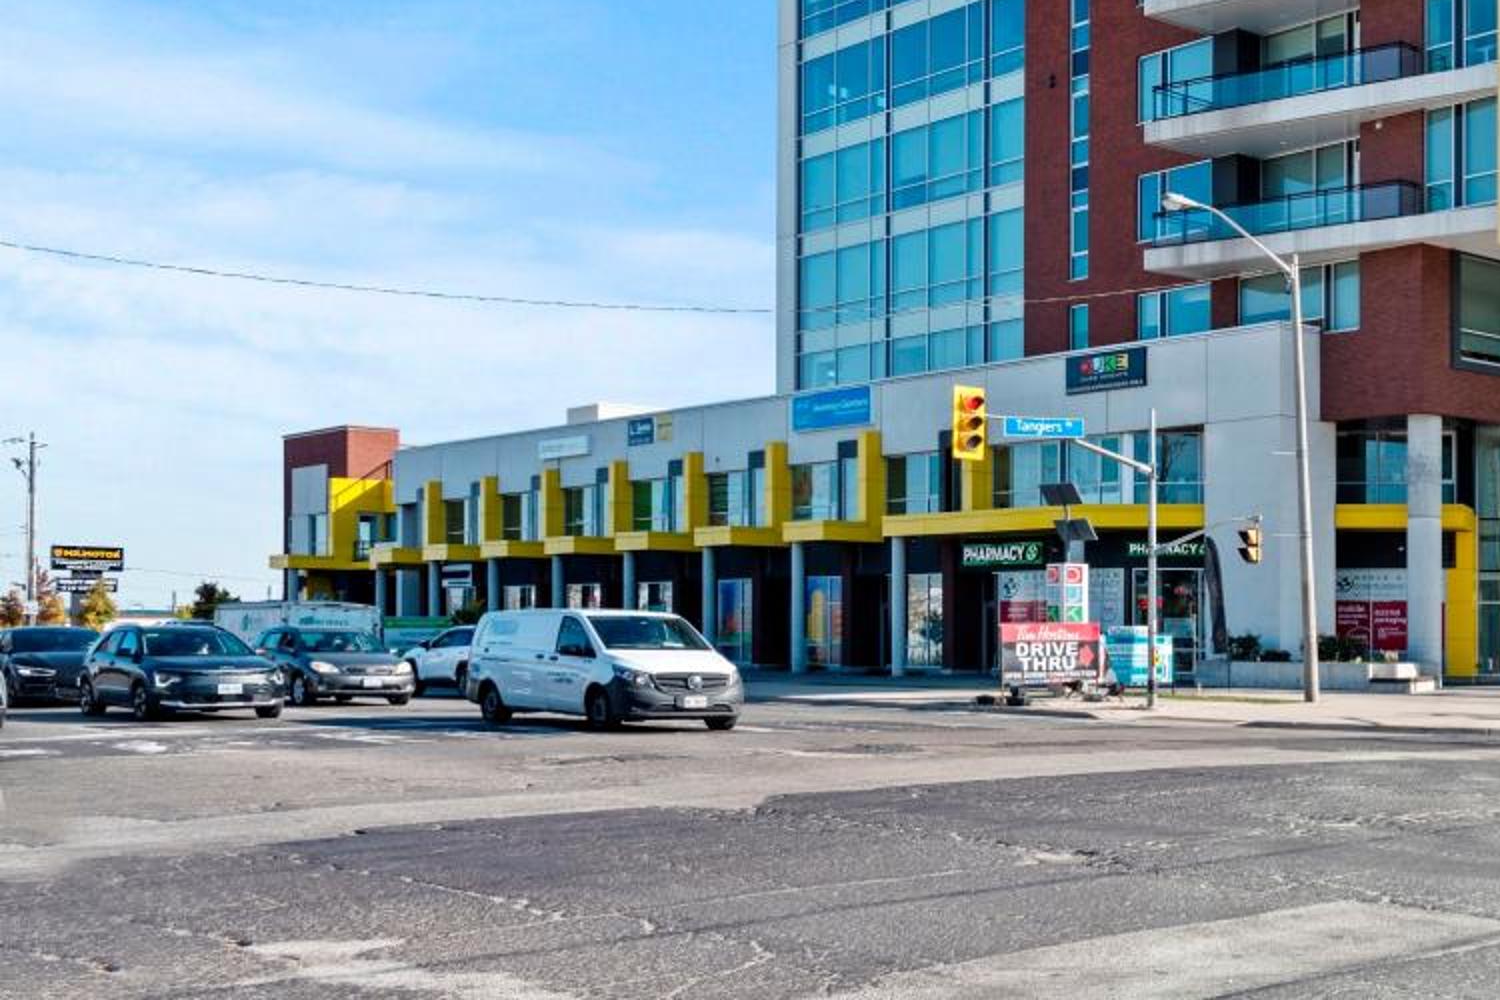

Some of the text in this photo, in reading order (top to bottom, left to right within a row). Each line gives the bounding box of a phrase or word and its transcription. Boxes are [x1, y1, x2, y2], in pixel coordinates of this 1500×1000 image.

[1015, 419, 1063, 436] Tangiers
[963, 545, 1025, 562] PHARMACY
[1129, 543, 1199, 555] PHACY
[1015, 641, 1079, 657] DRIVE
[1018, 656, 1076, 671] THRU
